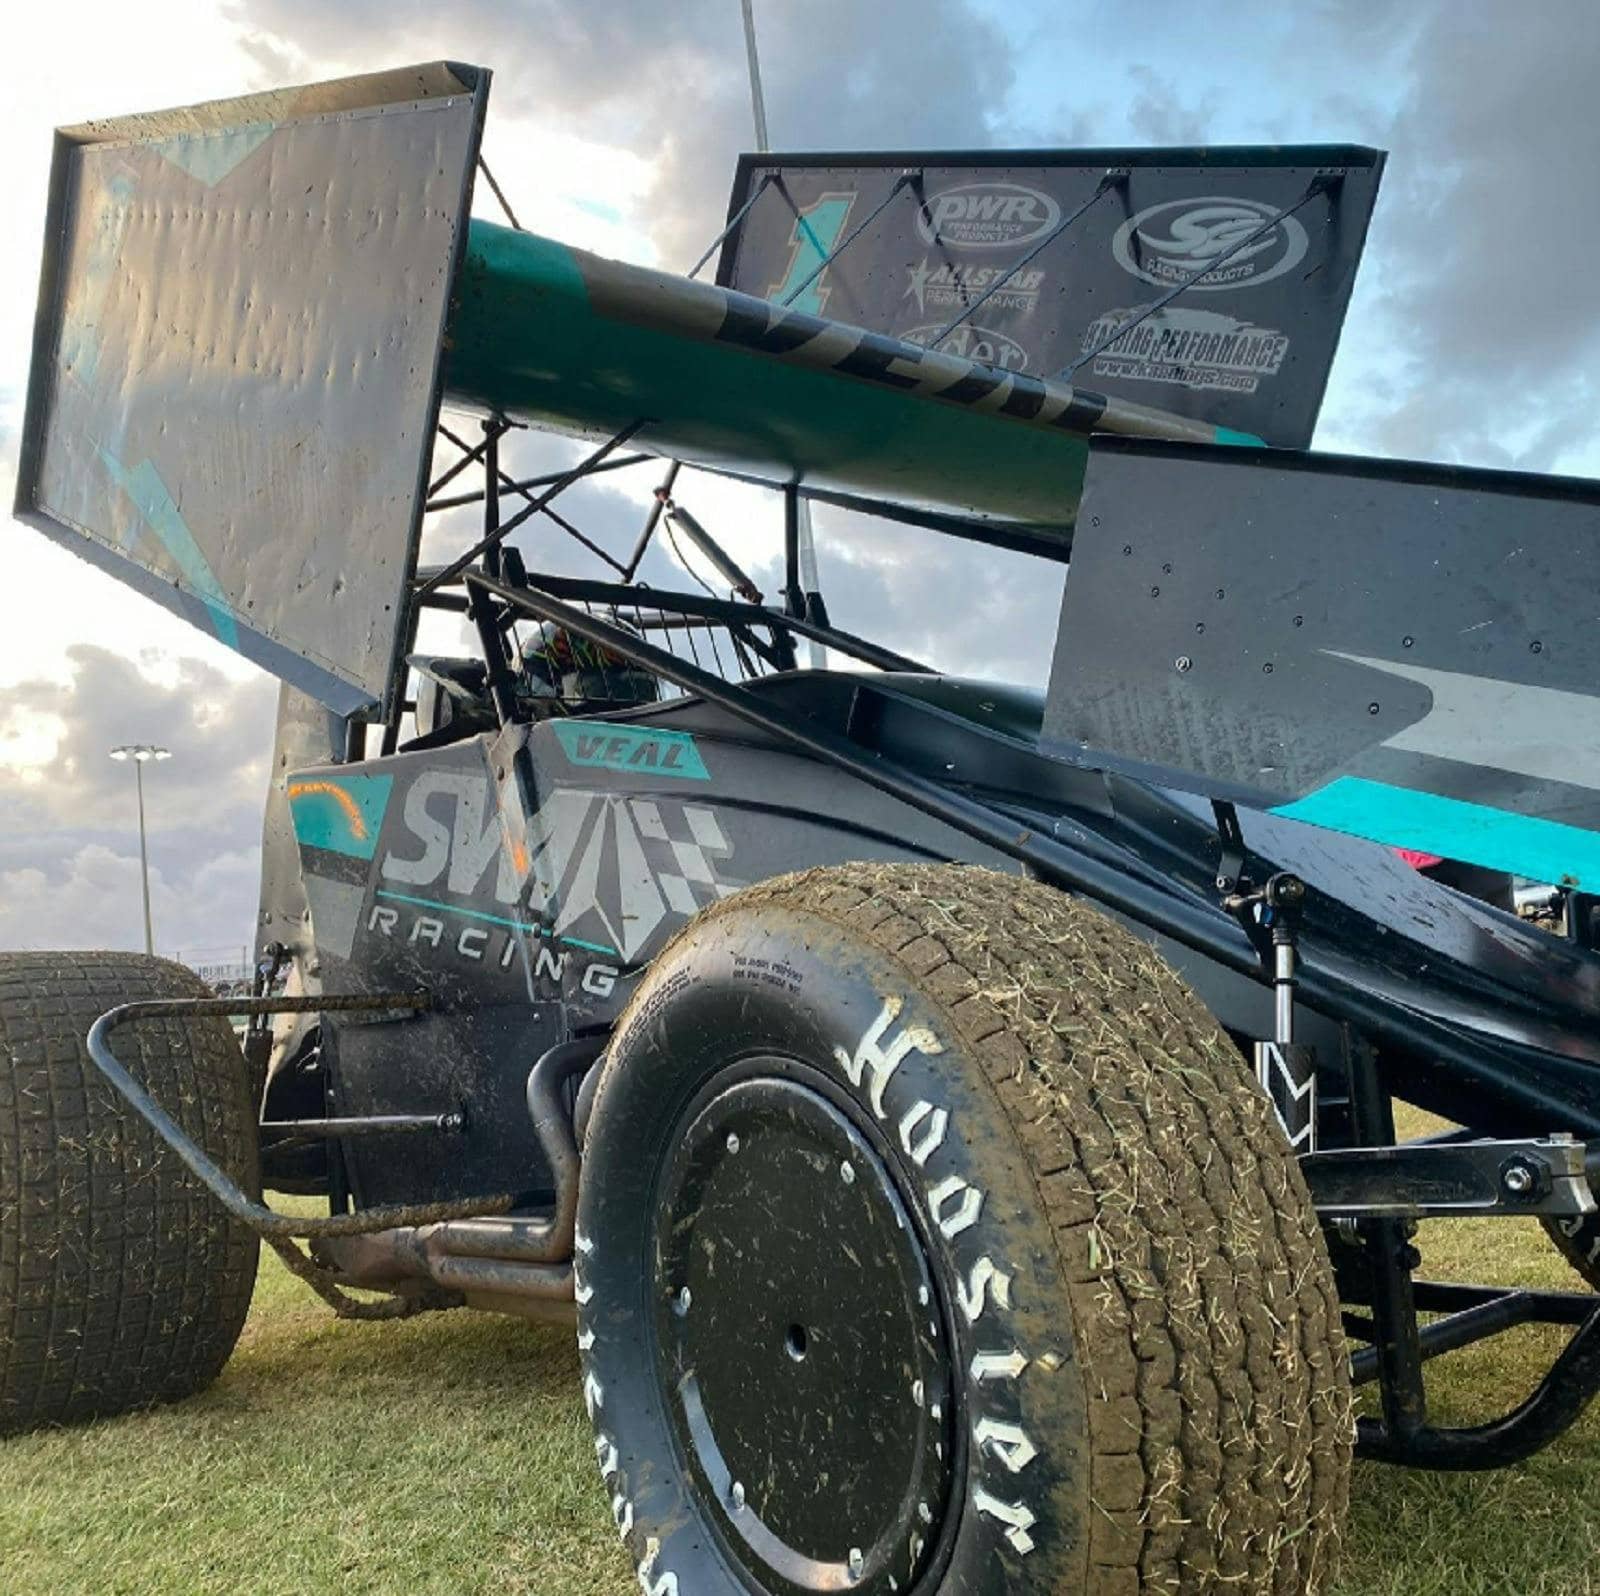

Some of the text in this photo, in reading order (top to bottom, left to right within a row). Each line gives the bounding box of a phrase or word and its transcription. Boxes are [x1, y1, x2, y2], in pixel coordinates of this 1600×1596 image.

[932, 195, 1046, 232] PWR
[764, 191, 857, 317] 1
[926, 263, 1045, 290] ALLSTAR
[1195, 263, 1256, 284] RODUCTS
[926, 289, 1038, 313] PERFOMANCE
[576, 734, 684, 769] VEAL
[368, 905, 620, 999] RACING
